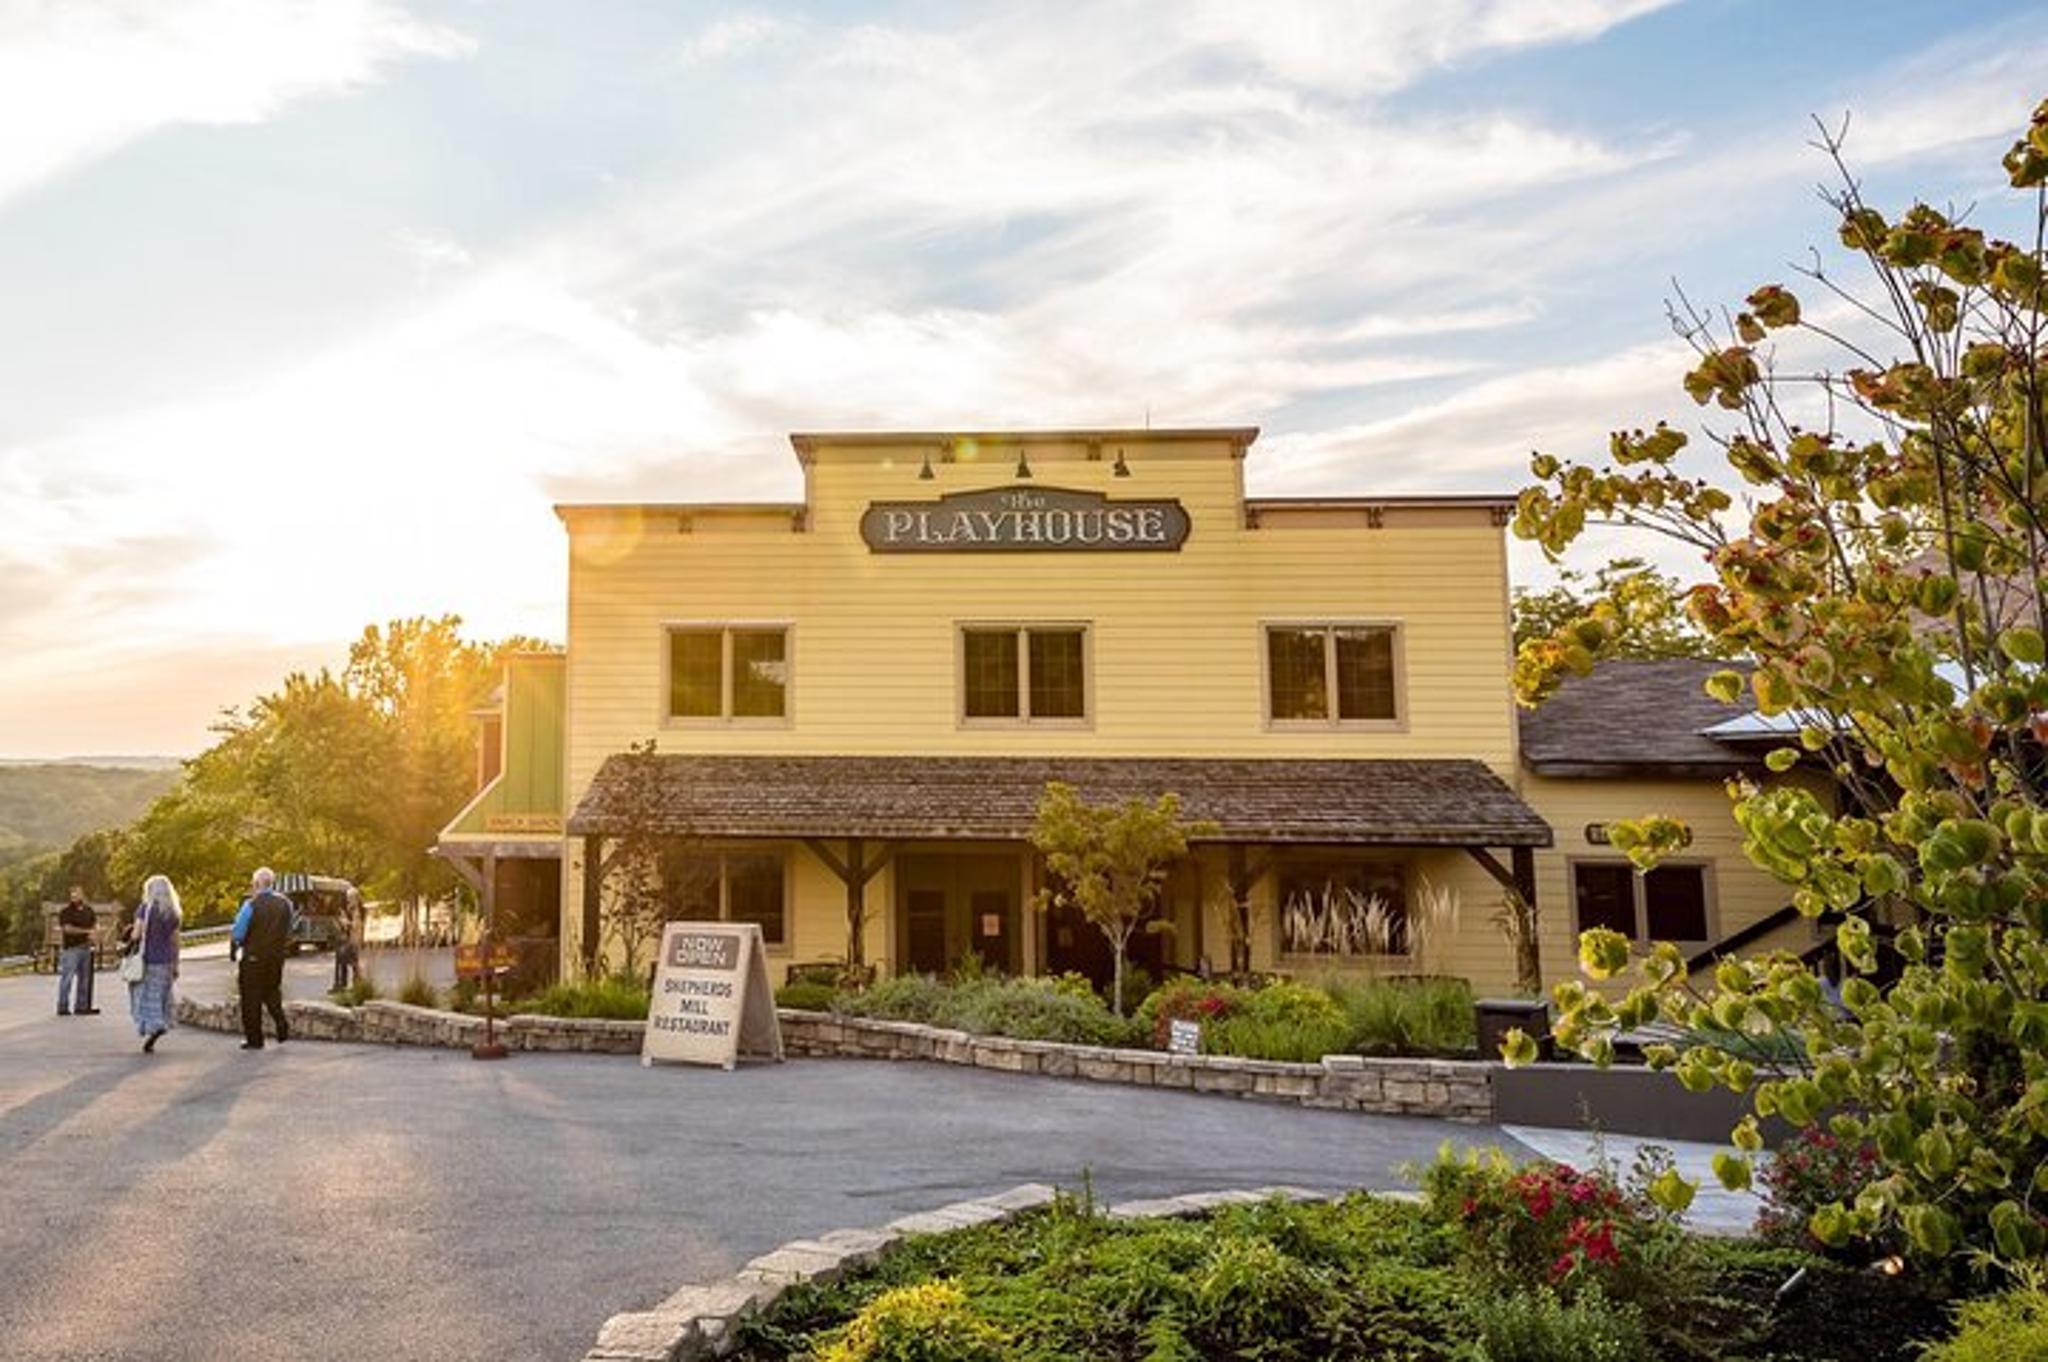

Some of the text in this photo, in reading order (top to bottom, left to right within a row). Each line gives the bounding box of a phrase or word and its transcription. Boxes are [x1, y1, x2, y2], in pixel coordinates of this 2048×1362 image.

[883, 508, 1167, 544] PLAYHOUSE
[681, 937, 725, 951] NOW
[675, 949, 727, 966] OPEN
[664, 978, 733, 998] SHEPHERDS
[679, 999, 709, 1015] MILL
[653, 1016, 730, 1035] RESTAURANT
